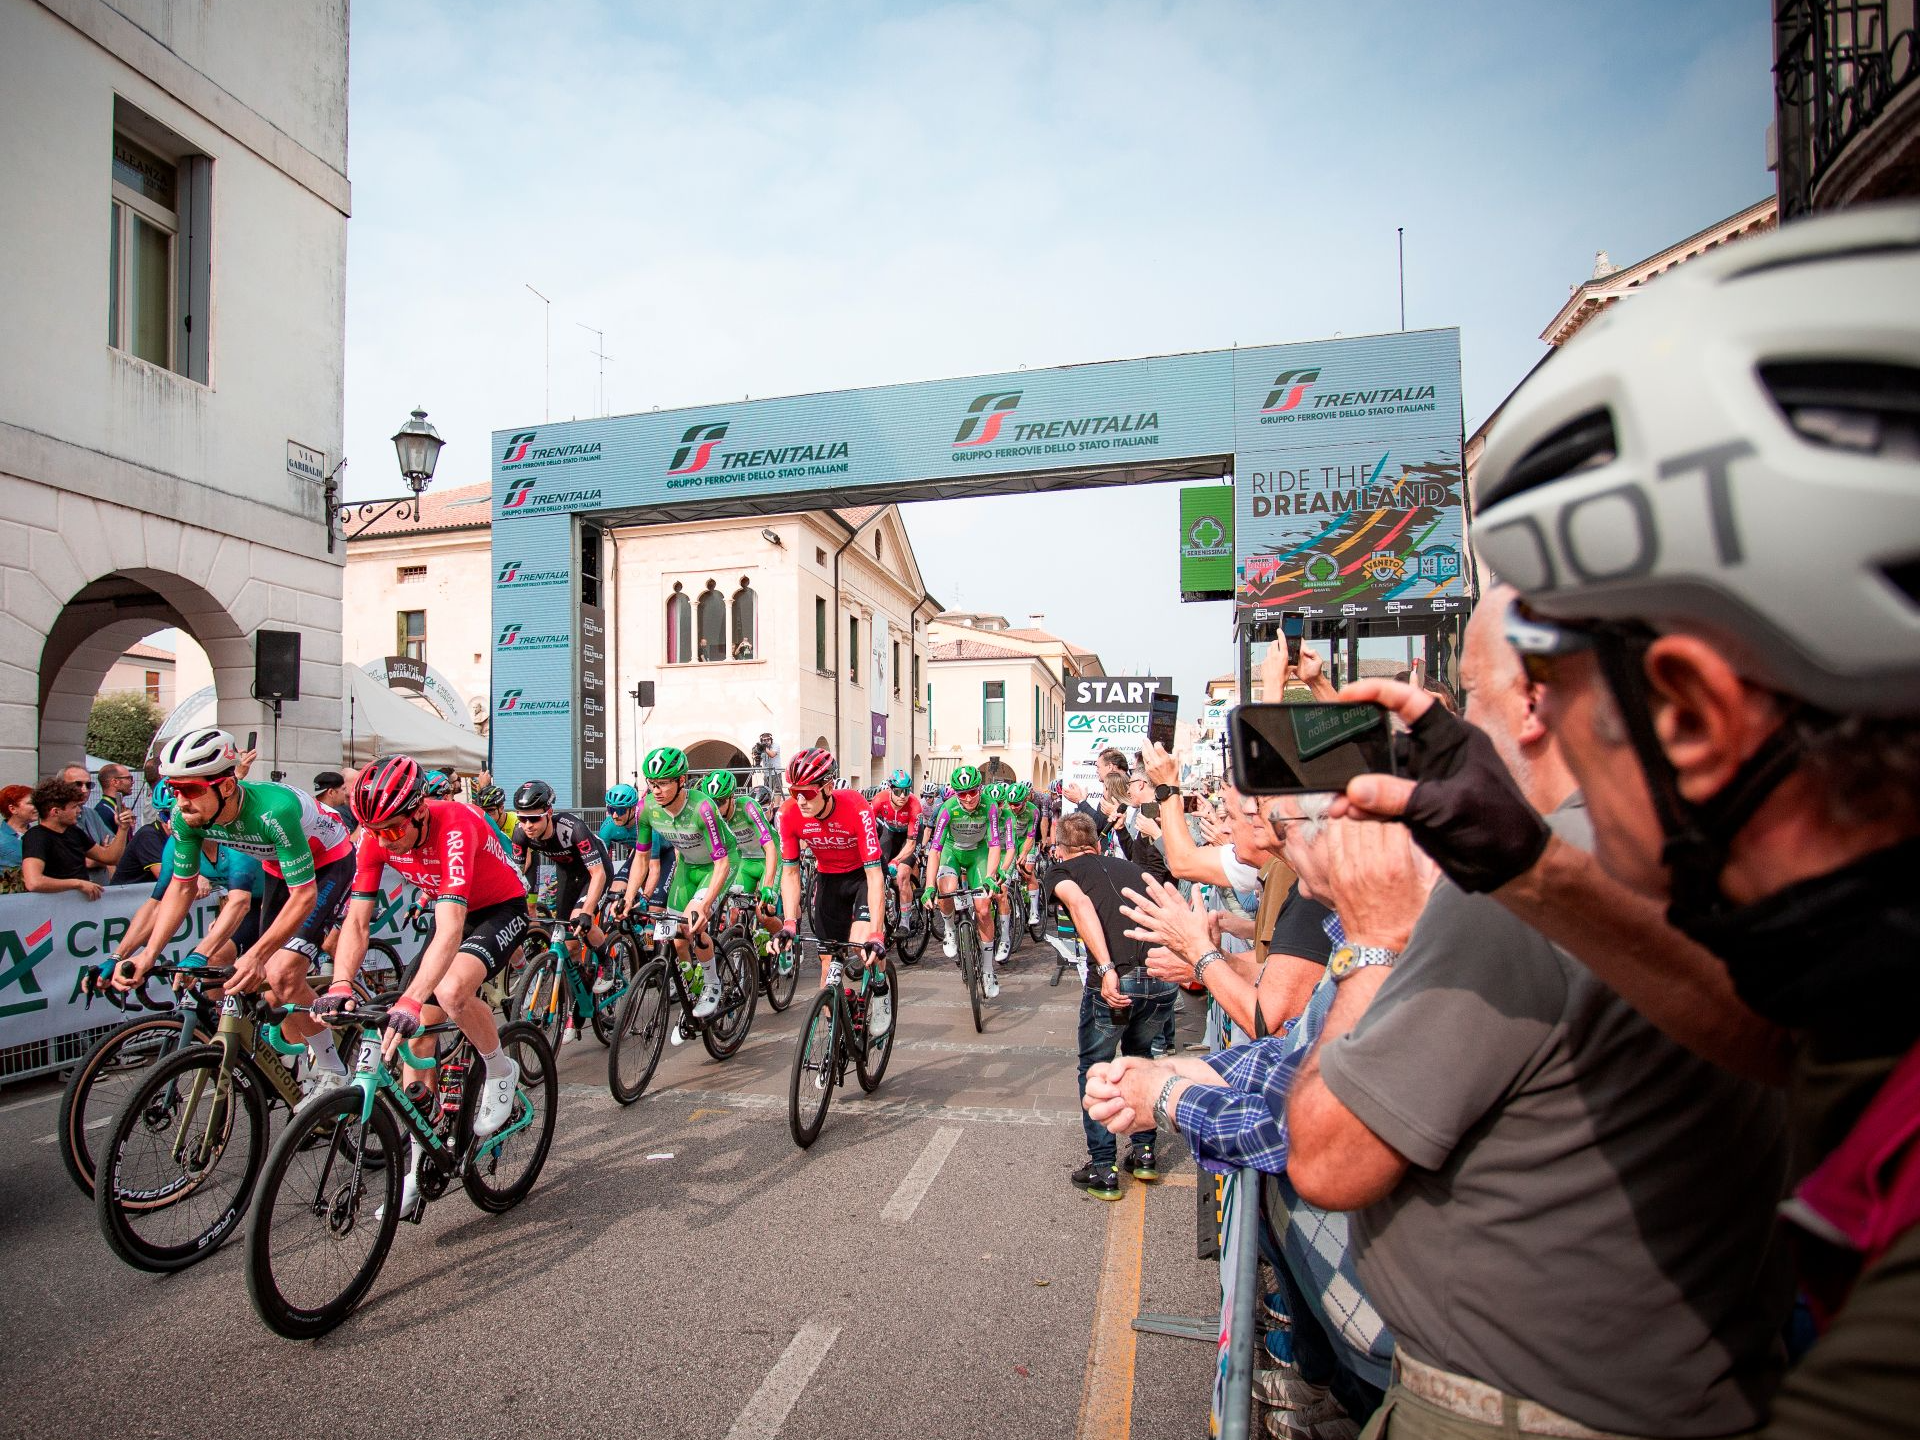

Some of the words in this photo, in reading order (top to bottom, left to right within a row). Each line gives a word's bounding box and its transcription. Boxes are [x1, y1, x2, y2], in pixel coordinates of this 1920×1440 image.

[1314, 385, 1435, 408] TRENITALIA
[1260, 415, 1295, 425] GRUPPO
[1297, 411, 1337, 422] FERROVIE
[1339, 409, 1365, 418] DELLO
[1368, 406, 1394, 416] STATO
[1397, 403, 1435, 413] ITALIANE
[1014, 412, 1159, 441] TRENITALIA
[299, 450, 314, 463] VIA
[532, 442, 601, 459] TRENITALIA
[721, 441, 849, 469] TRENITALIA
[951, 450, 992, 462] GRUPPO
[995, 445, 1042, 458] FERROVIE
[1044, 442, 1076, 454] DELLO
[1079, 439, 1110, 451] STATO
[1113, 435, 1159, 448] ITALIANE
[289, 458, 323, 479] GARIBALDI
[522, 461, 546, 469] FERROVIE
[666, 478, 702, 489] GRUPPO
[705, 473, 745, 485] FERROVIE
[748, 471, 775, 481] DELLO
[778, 467, 806, 478] STATO
[808, 463, 849, 475] ITALIANE
[1252, 468, 1311, 494] RIDE
[1320, 463, 1373, 488] THE
[532, 489, 602, 505] TRENITALIA
[1252, 482, 1446, 518] DREAMLAND
[522, 506, 546, 514] FERROVIE
[1366, 559, 1400, 570] VENETO
[1423, 566, 1434, 574] NE
[1442, 565, 1456, 573] GO
[519, 571, 569, 581] TRENITALIA
[519, 634, 569, 645] TRENITALIA
[394, 663, 407, 672] RIDE
[408, 664, 420, 673] THE
[388, 671, 425, 683] DREAMLAND
[1076, 681, 1161, 704] START
[520, 701, 570, 710] TRENITALIA
[1098, 713, 1149, 724] CRÉDIT
[560, 816, 575, 827] BMC
[270, 818, 292, 848] everest
[858, 810, 878, 856] ARKEA
[483, 834, 506, 865] ARKEA
[581, 849, 600, 860] TUDOR
[286, 851, 312, 867] bralco
[446, 830, 466, 888] ARKEA
[401, 871, 442, 887] RKE
[495, 915, 527, 951] ARKEA
[660, 925, 671, 936] 30
[113, 1139, 128, 1201] URSUS
[198, 1208, 236, 1249] URSUS
